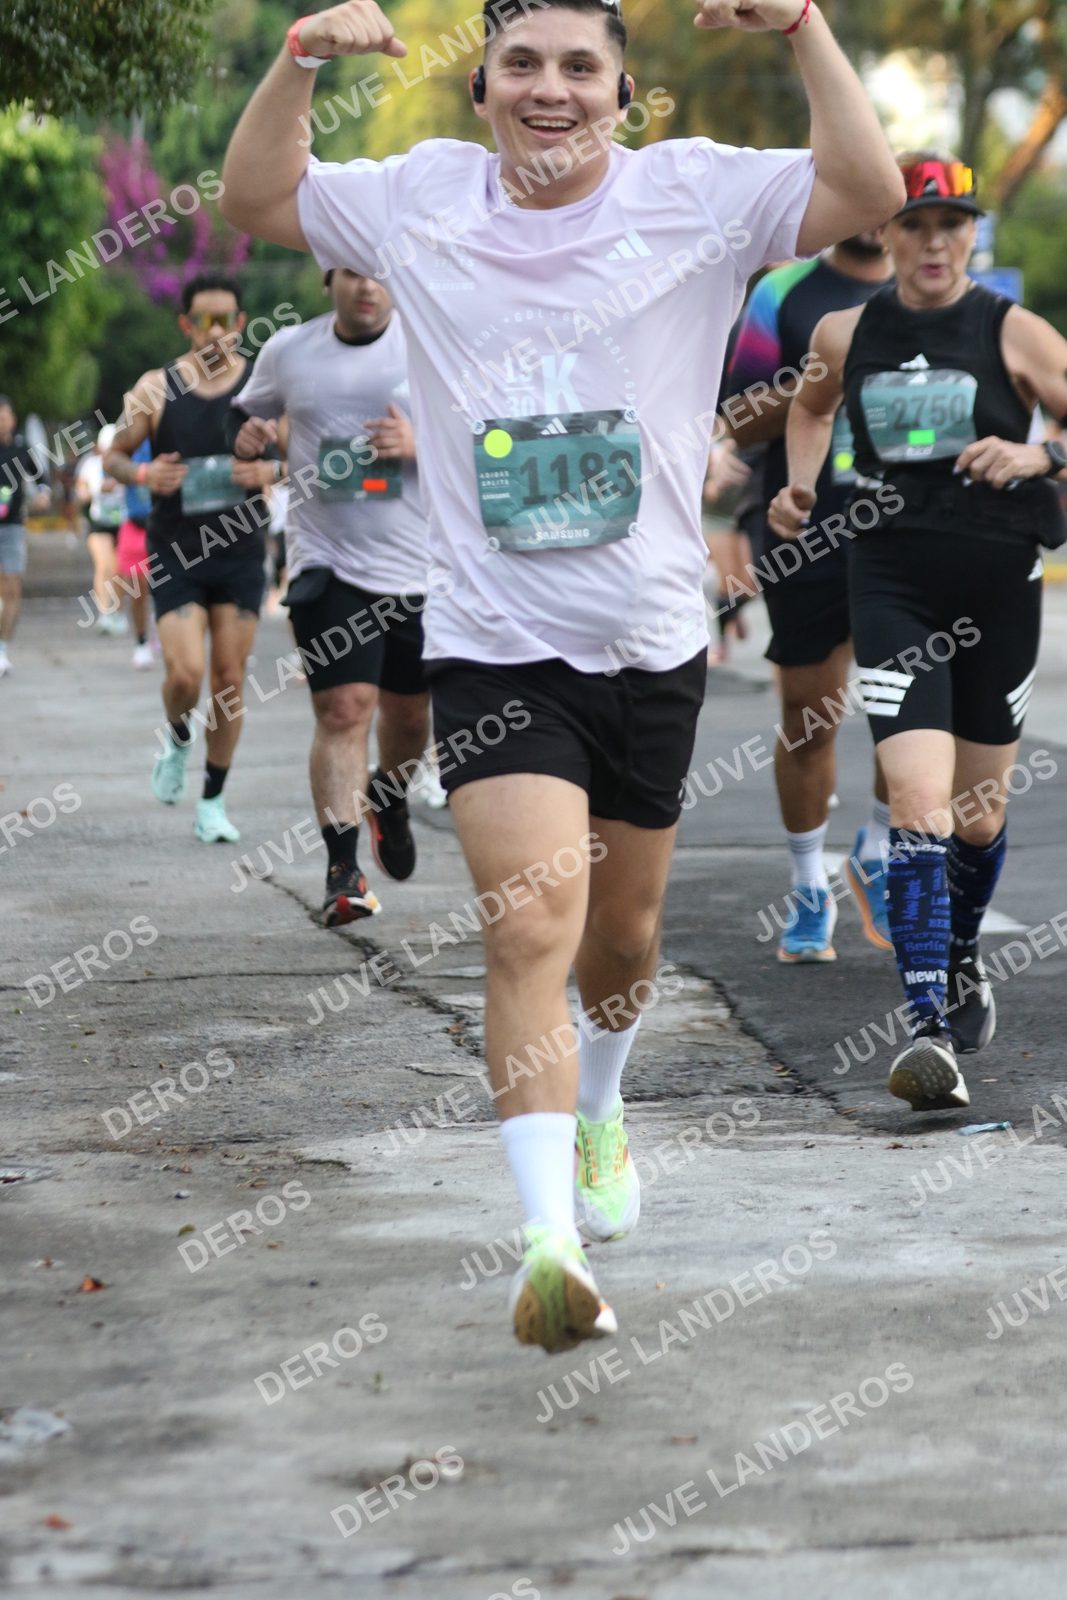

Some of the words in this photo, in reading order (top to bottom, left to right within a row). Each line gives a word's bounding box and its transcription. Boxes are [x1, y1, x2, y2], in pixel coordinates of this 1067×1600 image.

[514, 308, 544, 322] GDL
[602, 336, 628, 364] GDL
[624, 381, 637, 408] GD
[541, 352, 584, 414] K
[892, 393, 968, 430] 2750
[520, 449, 636, 505] 1183
[535, 528, 590, 541] SAMSUNG
